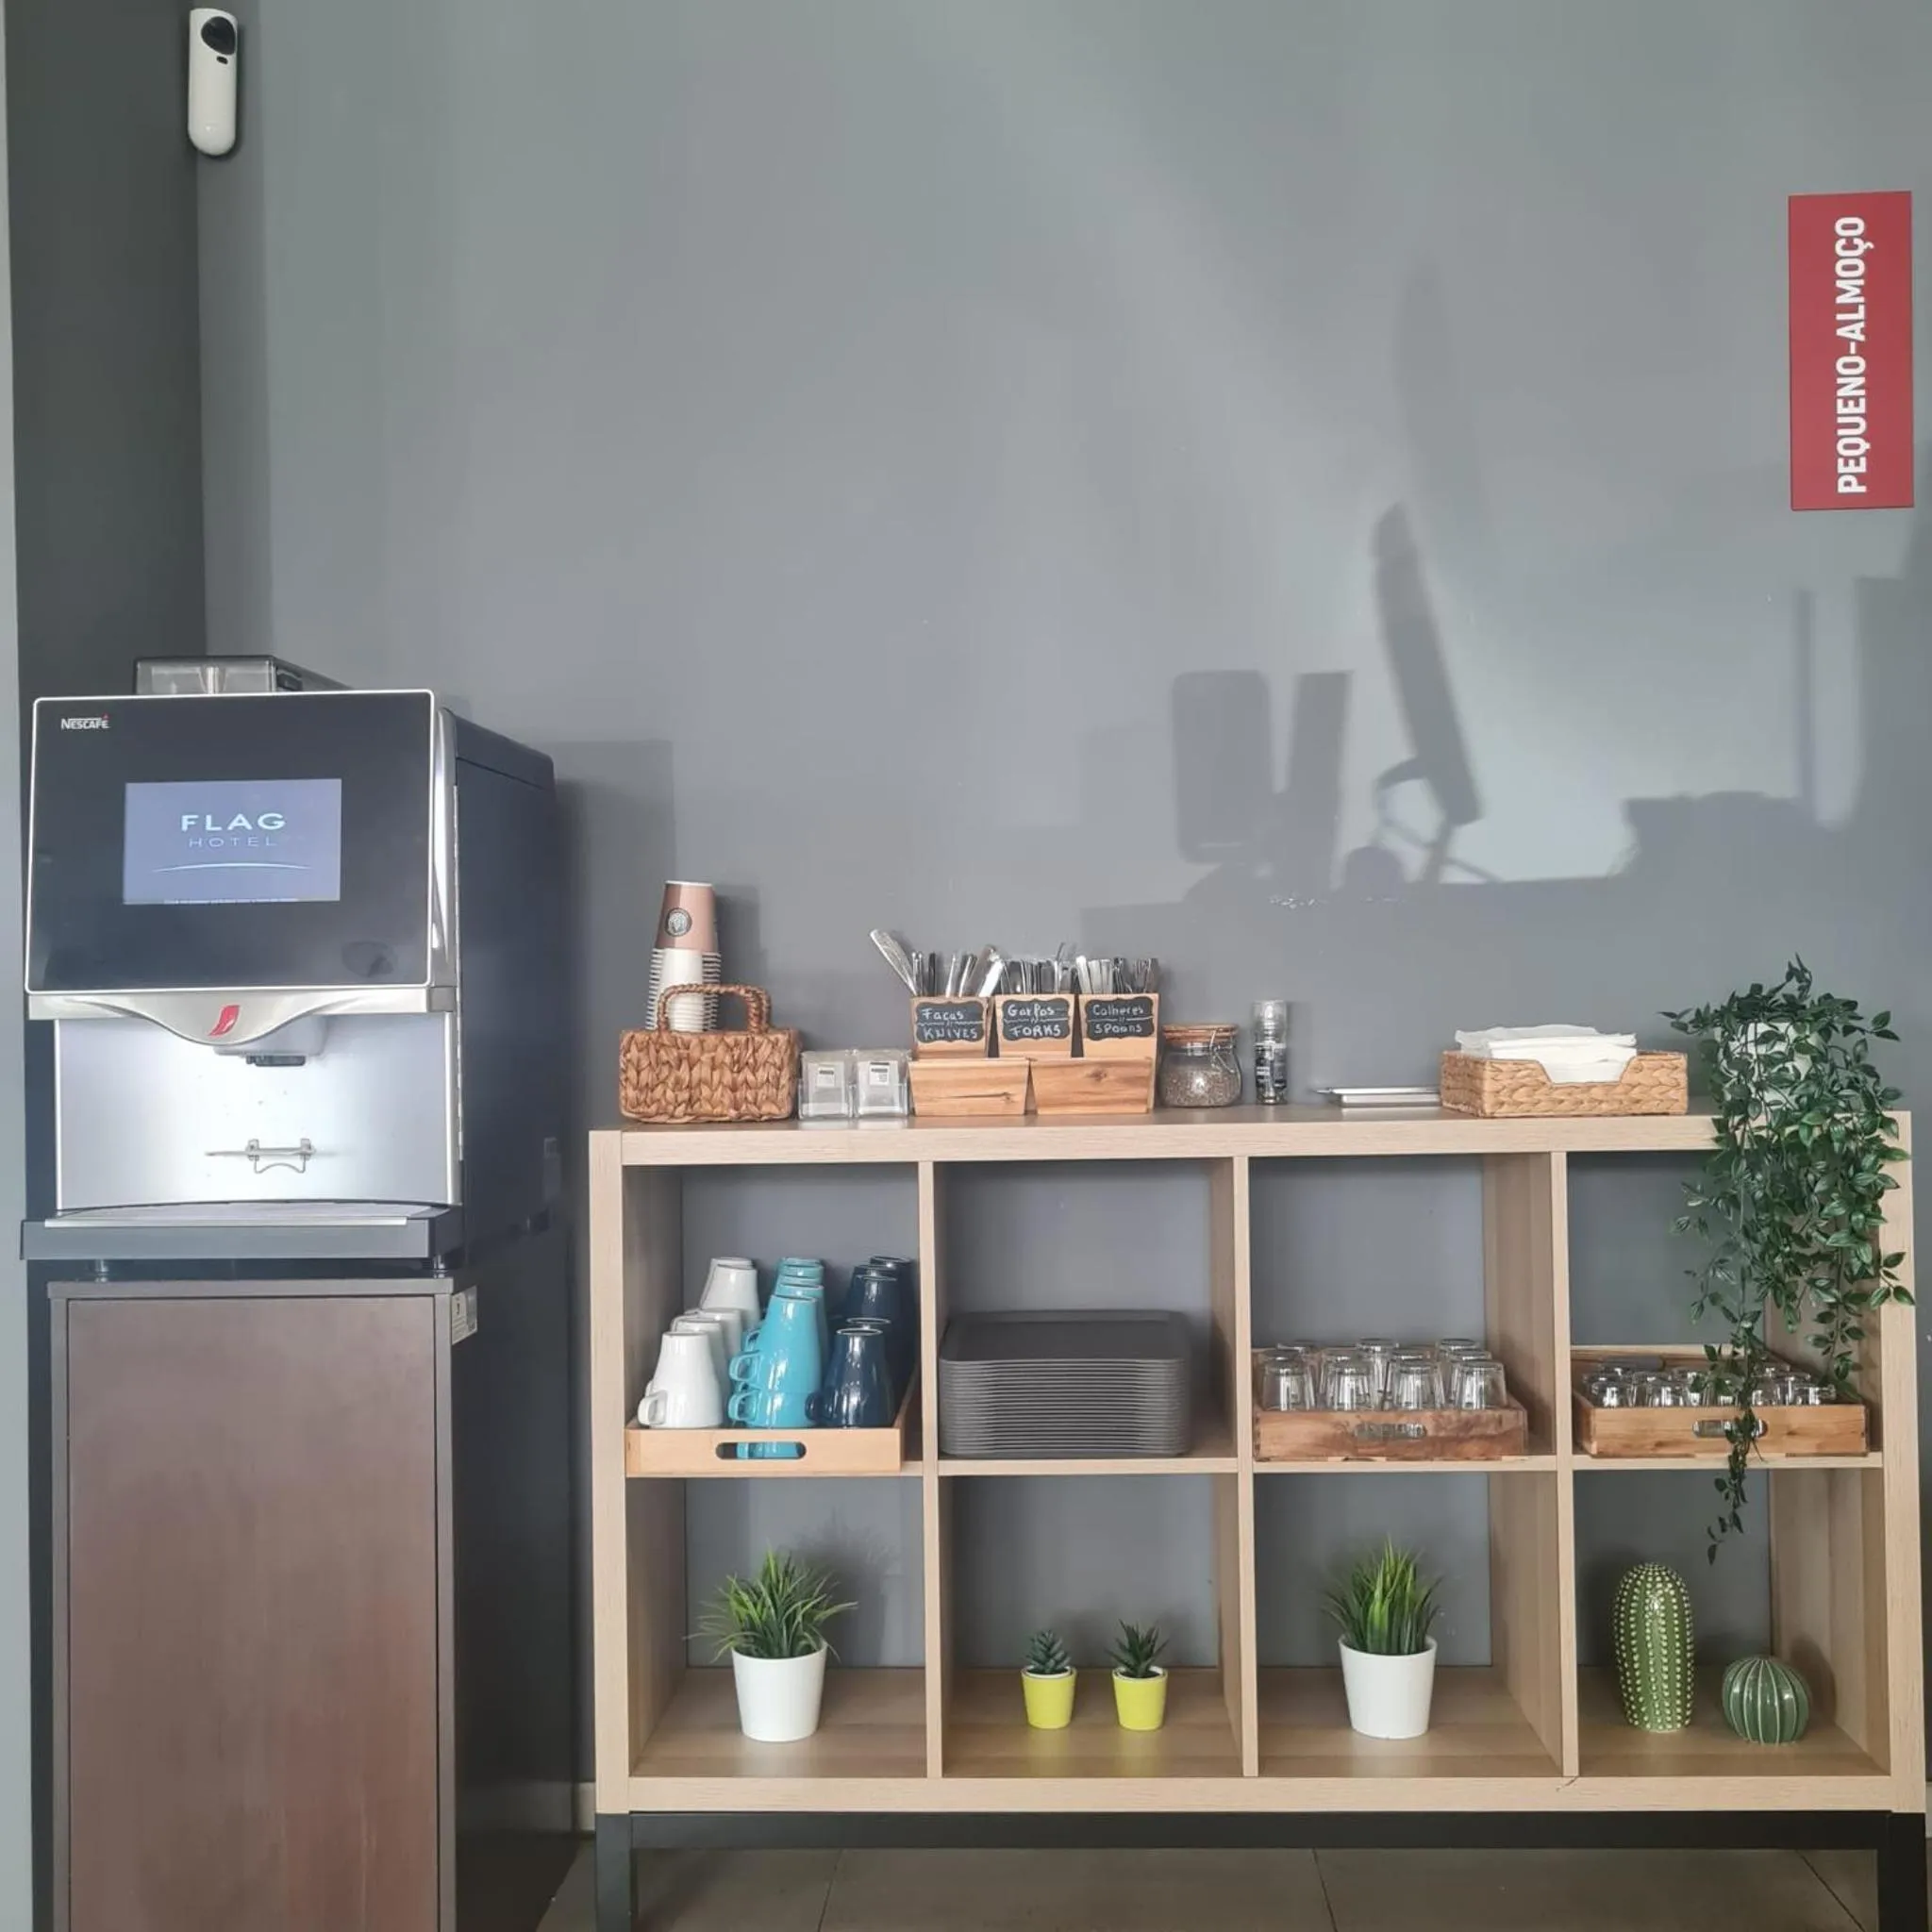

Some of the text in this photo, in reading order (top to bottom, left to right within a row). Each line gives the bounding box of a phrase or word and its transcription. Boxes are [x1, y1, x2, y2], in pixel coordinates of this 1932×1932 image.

[1834, 216, 1874, 493] PEQUENO-ALMOÇO
[181, 812, 286, 831] FLAG
[189, 836, 277, 848] HOTEL
[924, 1026, 978, 1041] KNIVES
[1008, 1024, 1061, 1037] FORKS
